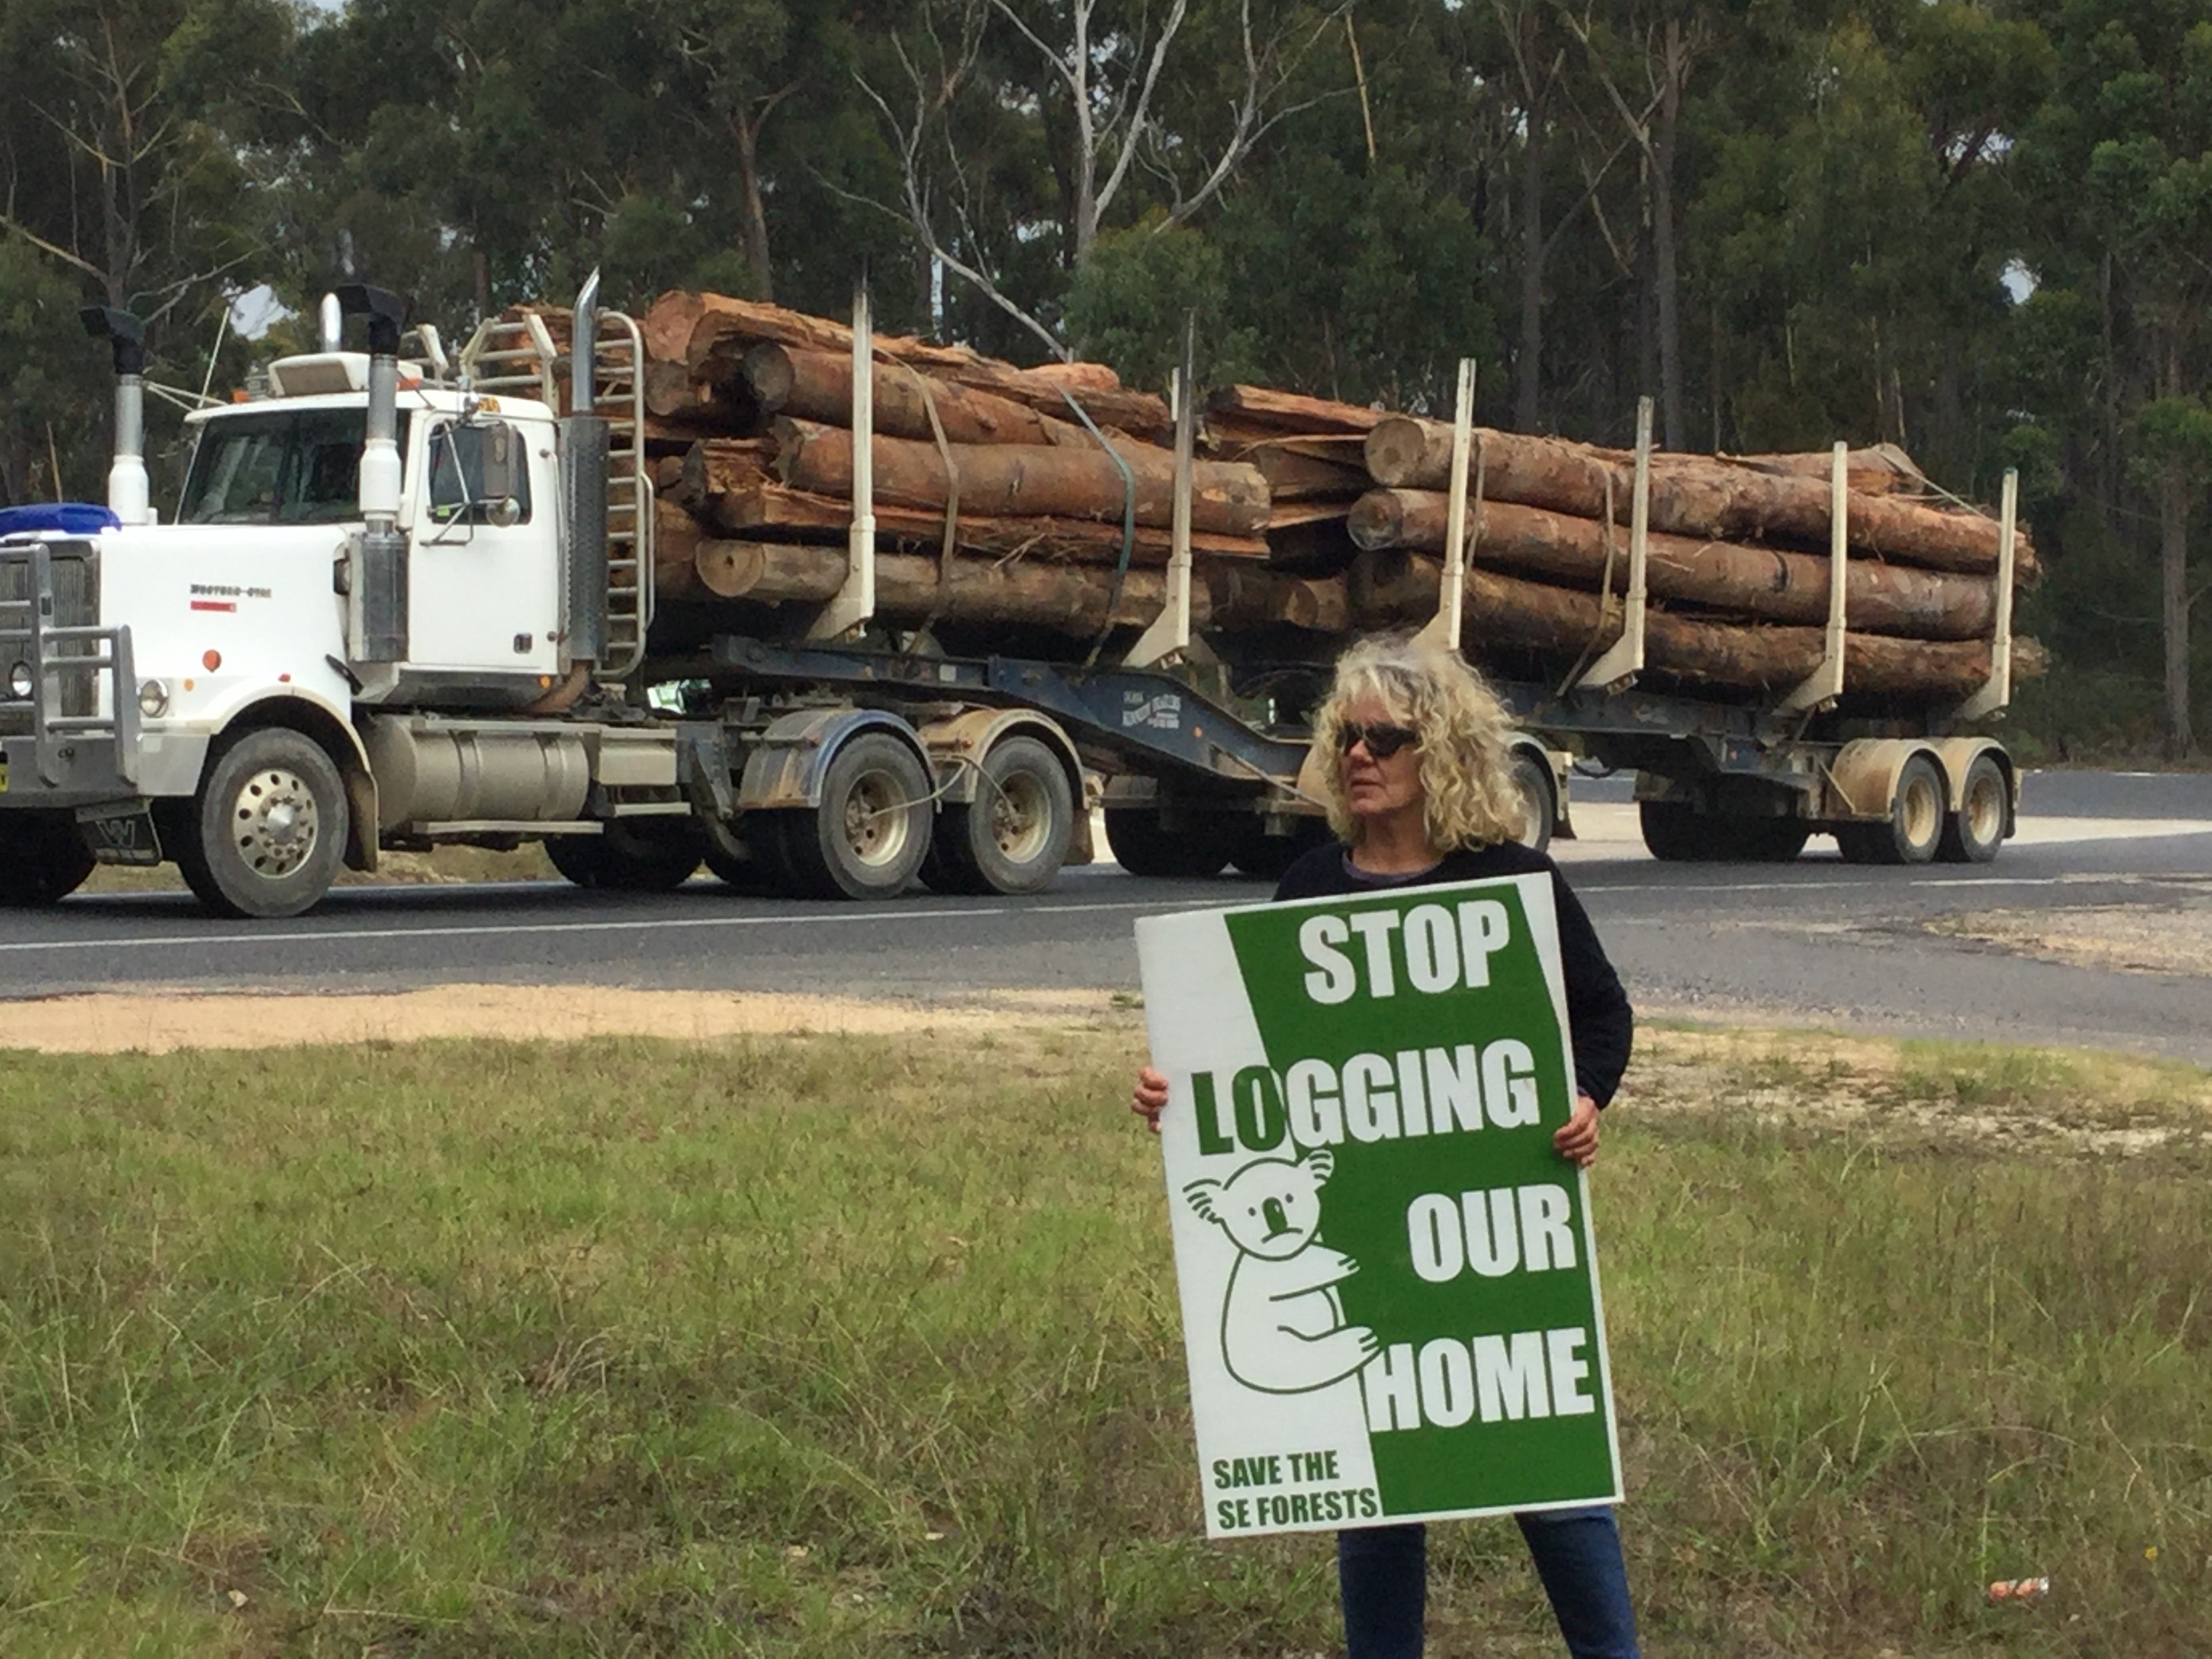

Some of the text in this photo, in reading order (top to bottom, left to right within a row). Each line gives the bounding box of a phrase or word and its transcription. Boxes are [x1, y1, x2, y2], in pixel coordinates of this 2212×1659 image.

[1298, 899, 1510, 1005] STOP
[1191, 1039, 1540, 1156] LOGGING
[1407, 1183, 1577, 1282] OUR
[1364, 1327, 1595, 1432] HOME
[1213, 1450, 1340, 1489] SAVE THE
[1217, 1488, 1378, 1530] SE FORESTS
